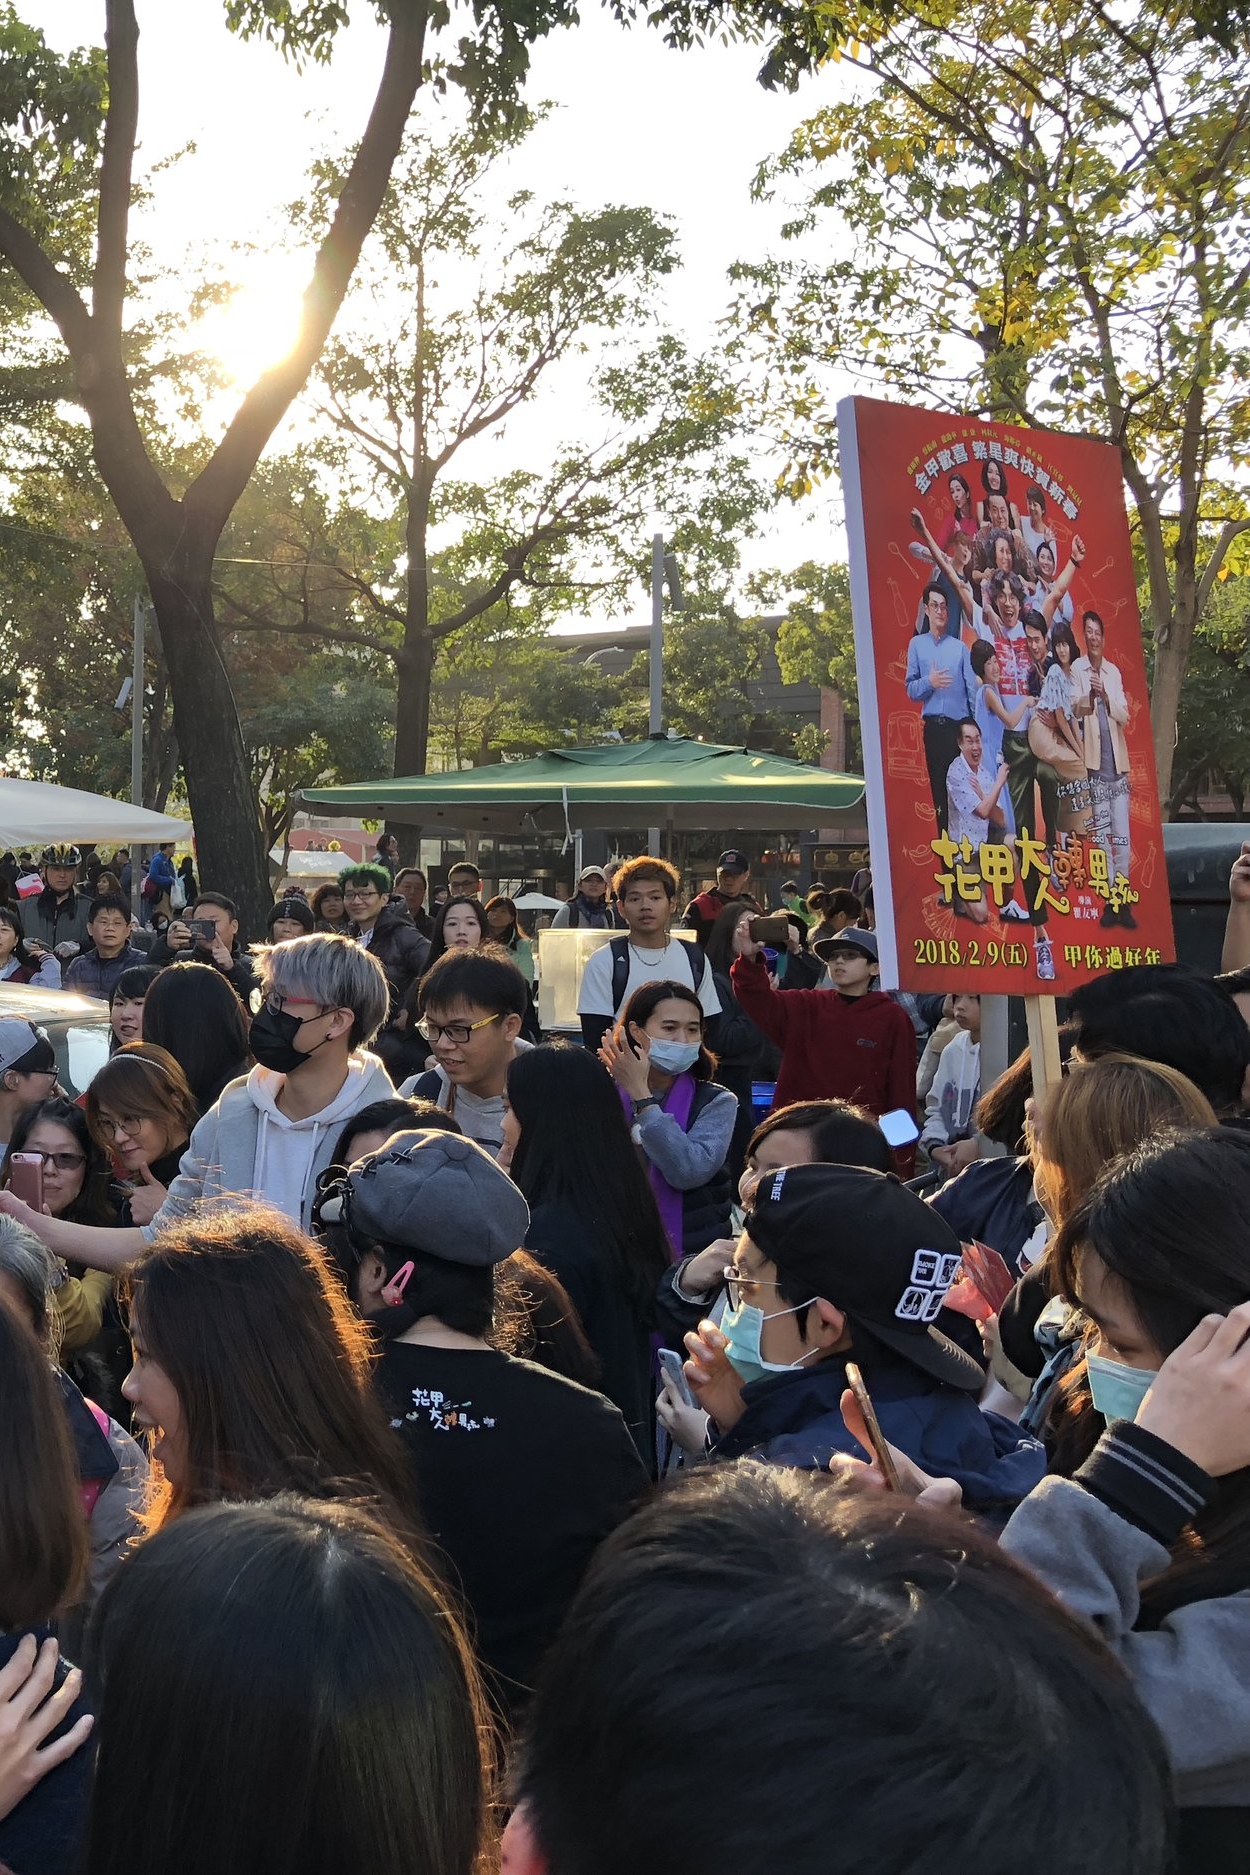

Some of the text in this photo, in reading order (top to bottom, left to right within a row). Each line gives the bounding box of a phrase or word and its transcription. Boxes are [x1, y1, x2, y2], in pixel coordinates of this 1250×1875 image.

[914, 440, 1079, 520] 金甲歡喜 繁星爽快賀新春
[930, 826, 1139, 914] 花甲大人轉男孩
[913, 938, 1028, 968] 2018/2/9(五)
[1064, 944, 1161, 970] 甲你過好年
[771, 1181, 783, 1201] TREE
[412, 1387, 444, 1408] 花甲
